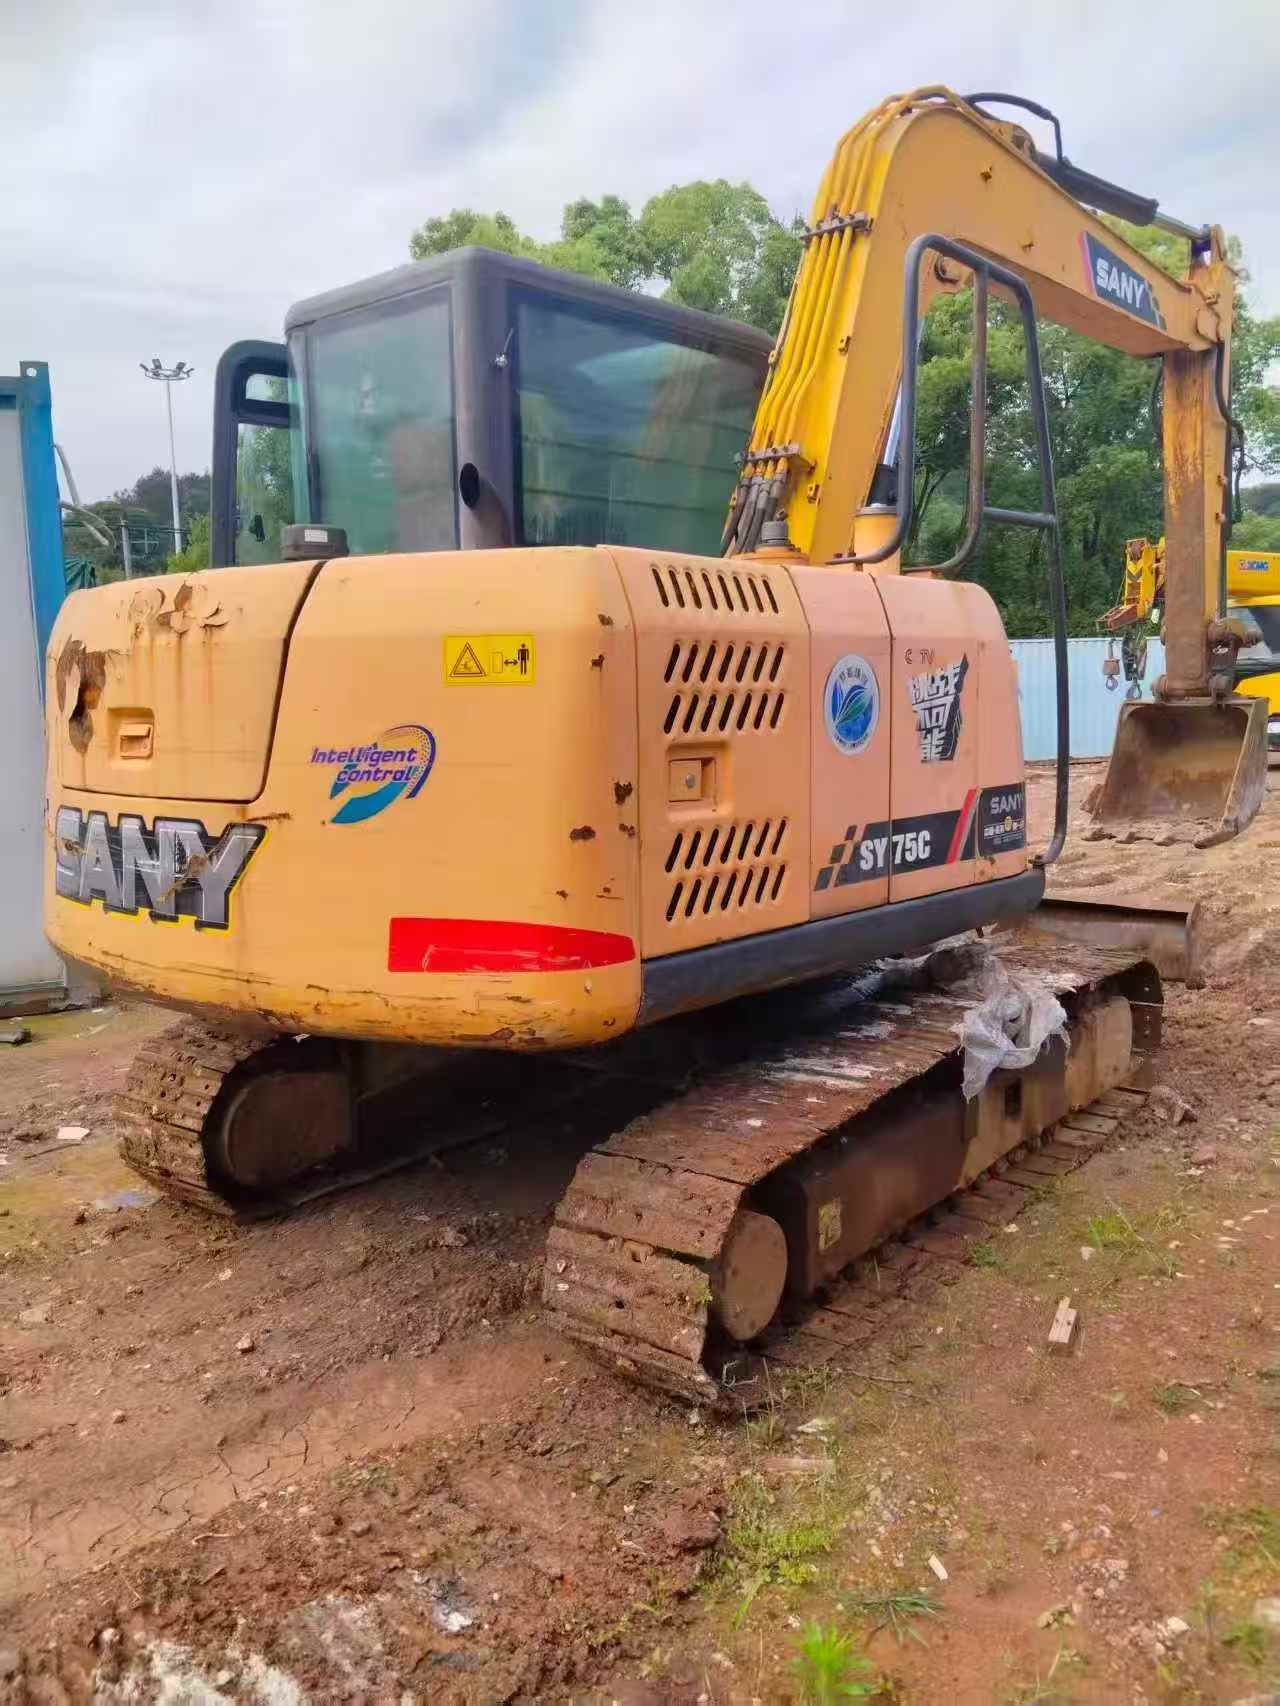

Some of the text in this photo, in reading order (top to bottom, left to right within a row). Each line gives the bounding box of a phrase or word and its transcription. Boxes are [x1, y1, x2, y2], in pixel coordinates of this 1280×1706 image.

[1096, 259, 1144, 308] SANY
[311, 746, 417, 767] Intelligent
[336, 766, 414, 783] control
[55, 804, 268, 930] SANY
